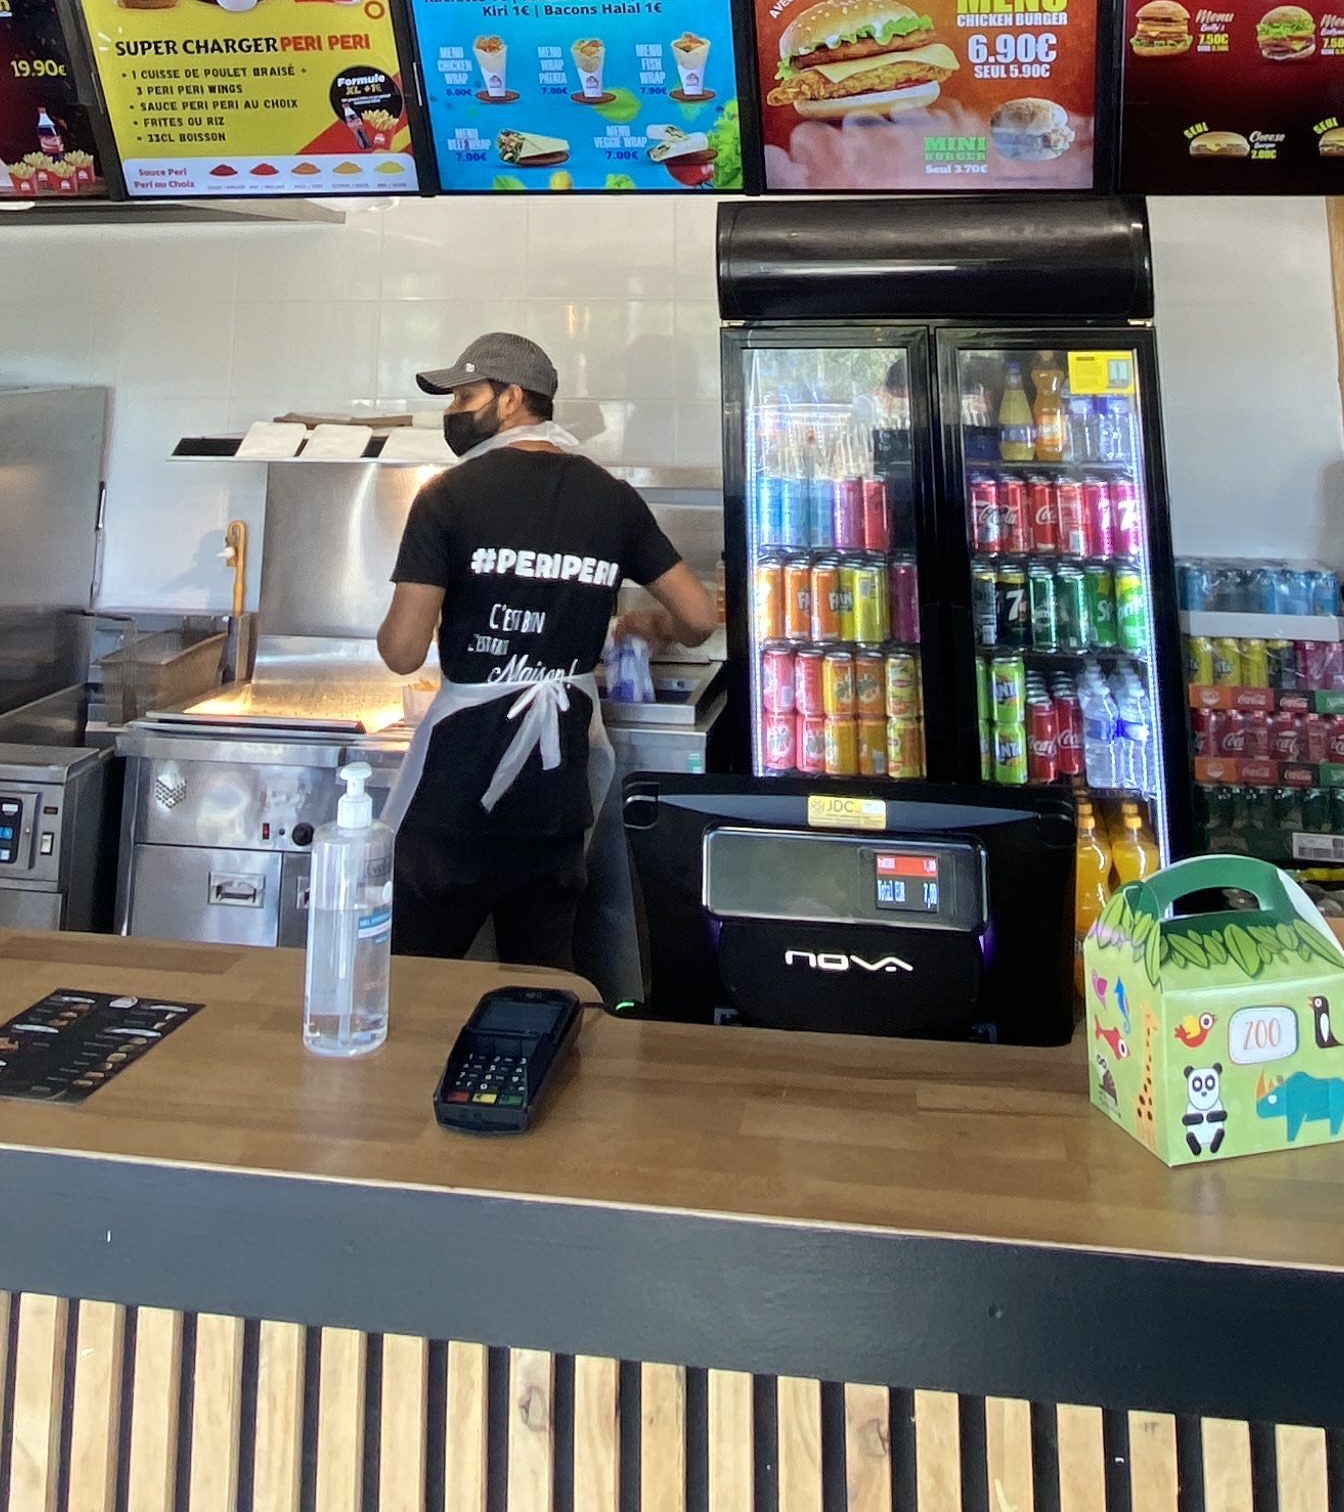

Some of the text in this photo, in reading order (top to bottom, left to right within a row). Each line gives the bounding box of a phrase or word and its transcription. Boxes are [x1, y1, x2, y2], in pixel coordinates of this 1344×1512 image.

[482, 2, 662, 17] Kiri 1€ Bacons Halal 1€
[1195, 9, 1235, 23] Menu
[957, 13, 1068, 27] CHICKEN BURGER
[115, 33, 370, 56] SUPER CHARGER PERI PERI
[968, 33, 1057, 64] 6.90€
[10, 60, 66, 77] 19.90€
[641, 57, 662, 70] FISH
[141, 63, 295, 80] CUISSE DE POULET BRAISÉ
[974, 64, 1050, 79] SEUL 5.90€
[337, 73, 385, 88] Formule
[147, 84, 243, 96] PERI PERI WINGS
[140, 98, 298, 112] SAUCE PERI PERI AU CHOIX
[143, 116, 225, 128] FRITES OU RIZ
[147, 132, 227, 144] 33CL BOISSON
[1248, 130, 1286, 142] Cheese
[924, 136, 986, 151] MINI
[456, 152, 487, 161] 7.00€
[605, 151, 638, 160] 7.00€
[138, 167, 187, 177] Sauce Peri
[168, 179, 195, 188] Choix
[471, 548, 620, 587] #PERIPERI
[489, 603, 523, 631] C'EST
[826, 800, 854, 813] JDC
[1243, 1018, 1281, 1051] ZOO
